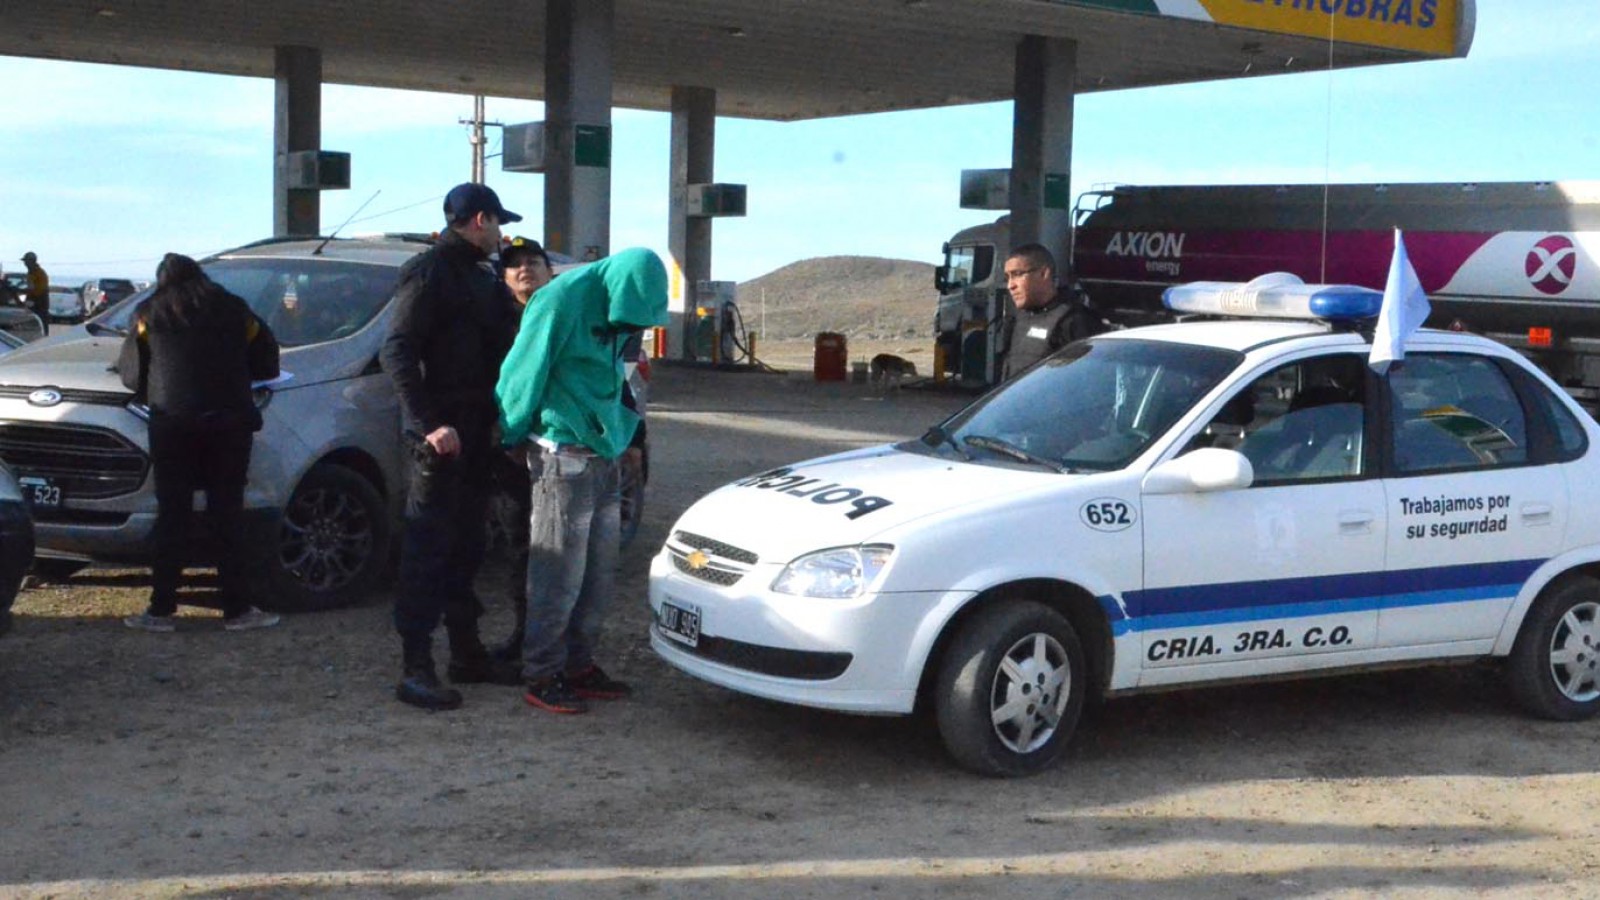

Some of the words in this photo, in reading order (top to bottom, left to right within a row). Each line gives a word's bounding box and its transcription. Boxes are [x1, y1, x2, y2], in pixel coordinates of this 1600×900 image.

[1243, 0, 1437, 29] OBRAS
[1105, 231, 1186, 258] AXION
[1145, 261, 1180, 276] energy
[34, 485, 61, 506] 523
[1399, 494, 1484, 516] Trabajamos
[1488, 495, 1510, 513] por
[1086, 502, 1131, 525] 652
[1406, 524, 1426, 539] su
[1430, 514, 1508, 540] seguridad
[1147, 635, 1222, 661] CRIA.
[1233, 628, 1292, 653] 3RA.
[1302, 625, 1353, 647] C.O.
